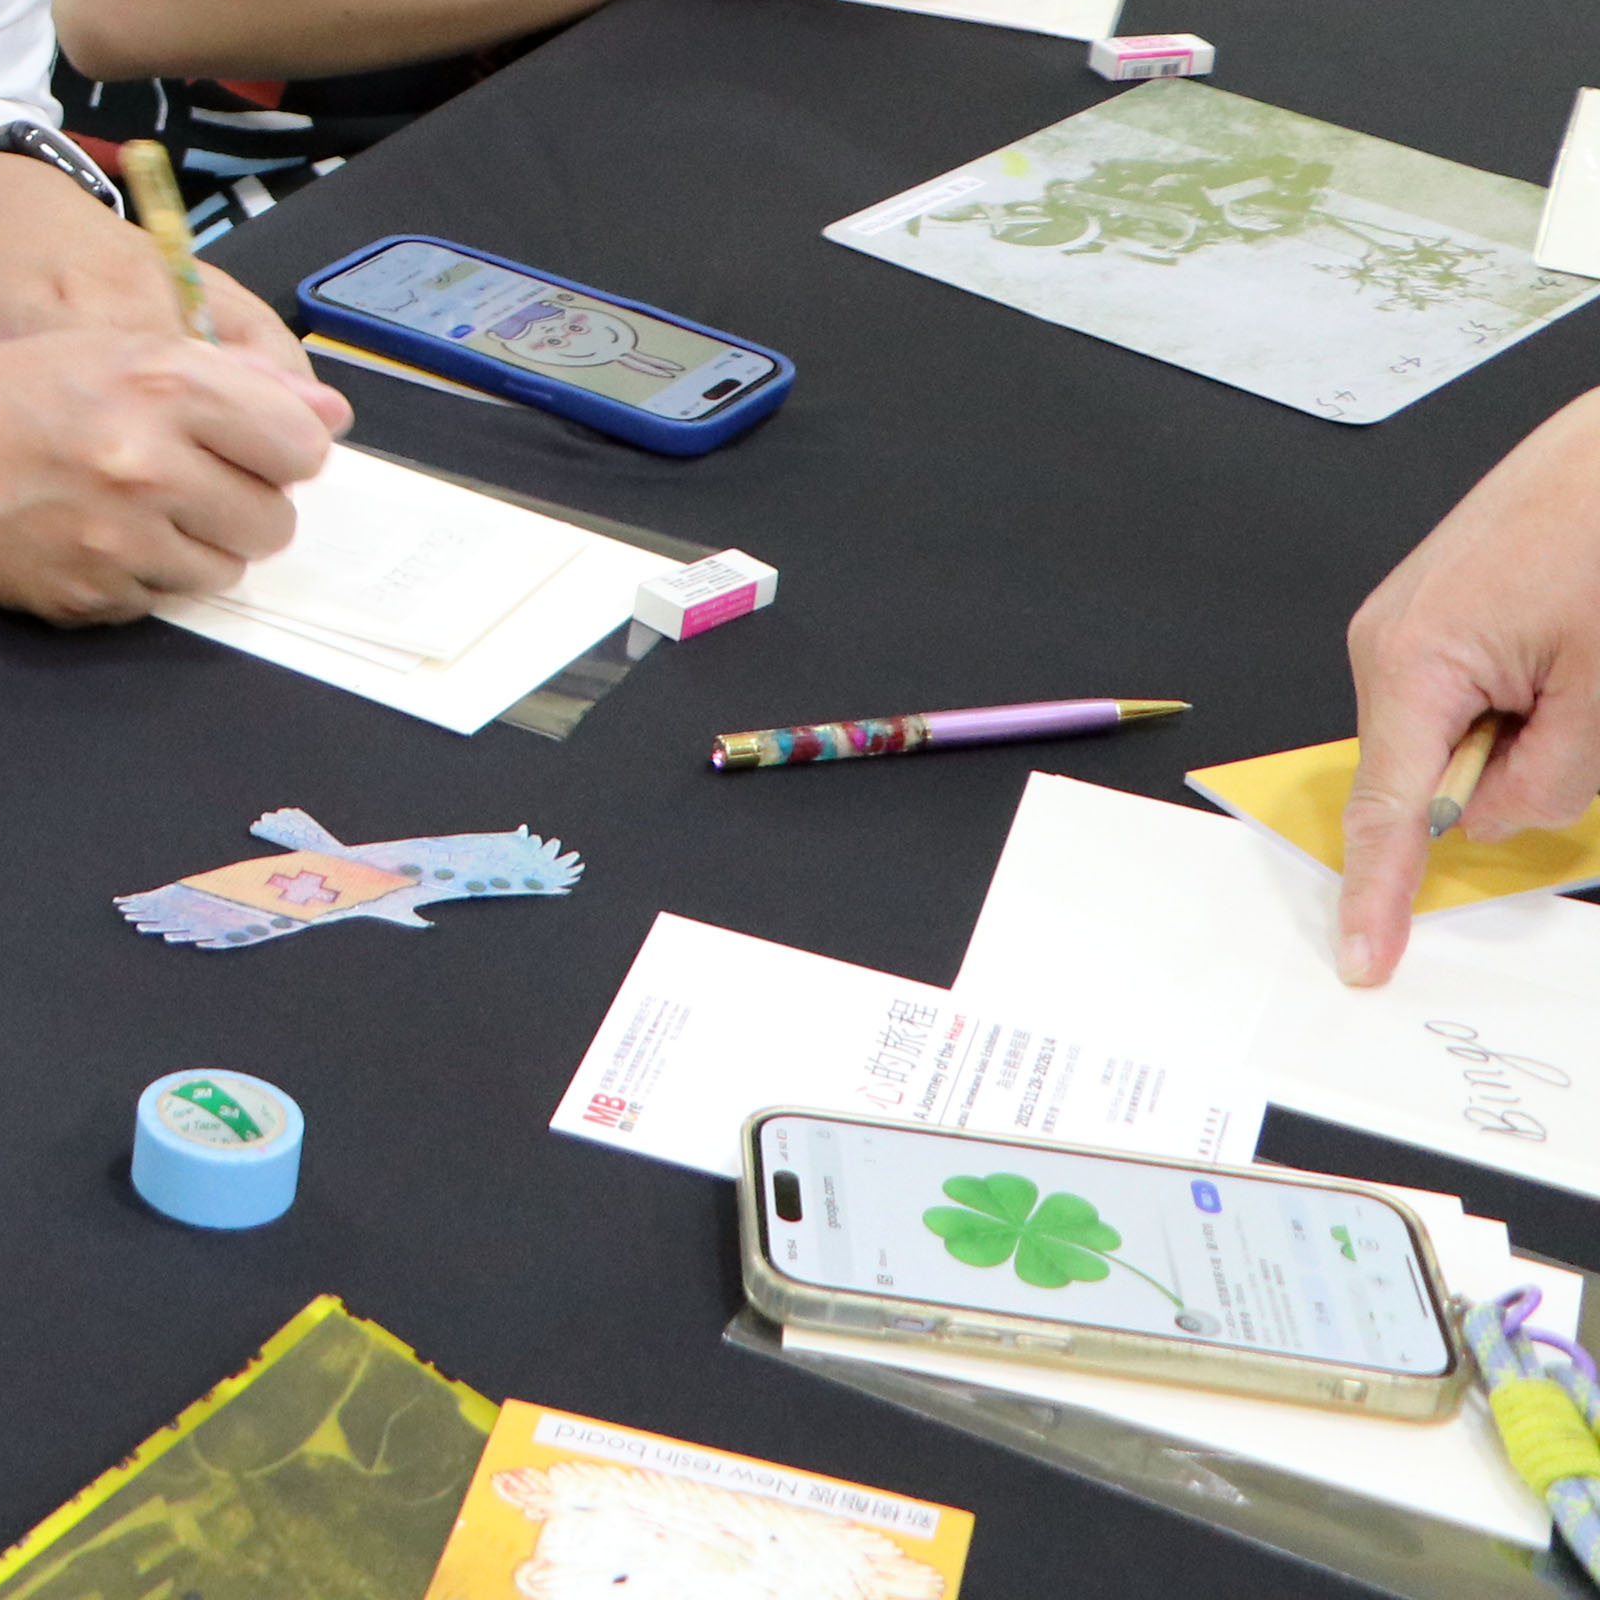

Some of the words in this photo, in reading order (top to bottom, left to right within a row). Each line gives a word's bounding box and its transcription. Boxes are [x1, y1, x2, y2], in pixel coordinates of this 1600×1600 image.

[856, 999, 938, 1110] 心的旅程
[917, 1071, 948, 1111] Journey
[935, 1041, 955, 1058] the
[945, 1013, 967, 1042] Heart
[582, 1093, 627, 1128] MB
[824, 1176, 842, 1229] google.com
[555, 1422, 646, 1458] board
[654, 1446, 722, 1475] resin
[730, 1466, 798, 1496] New
